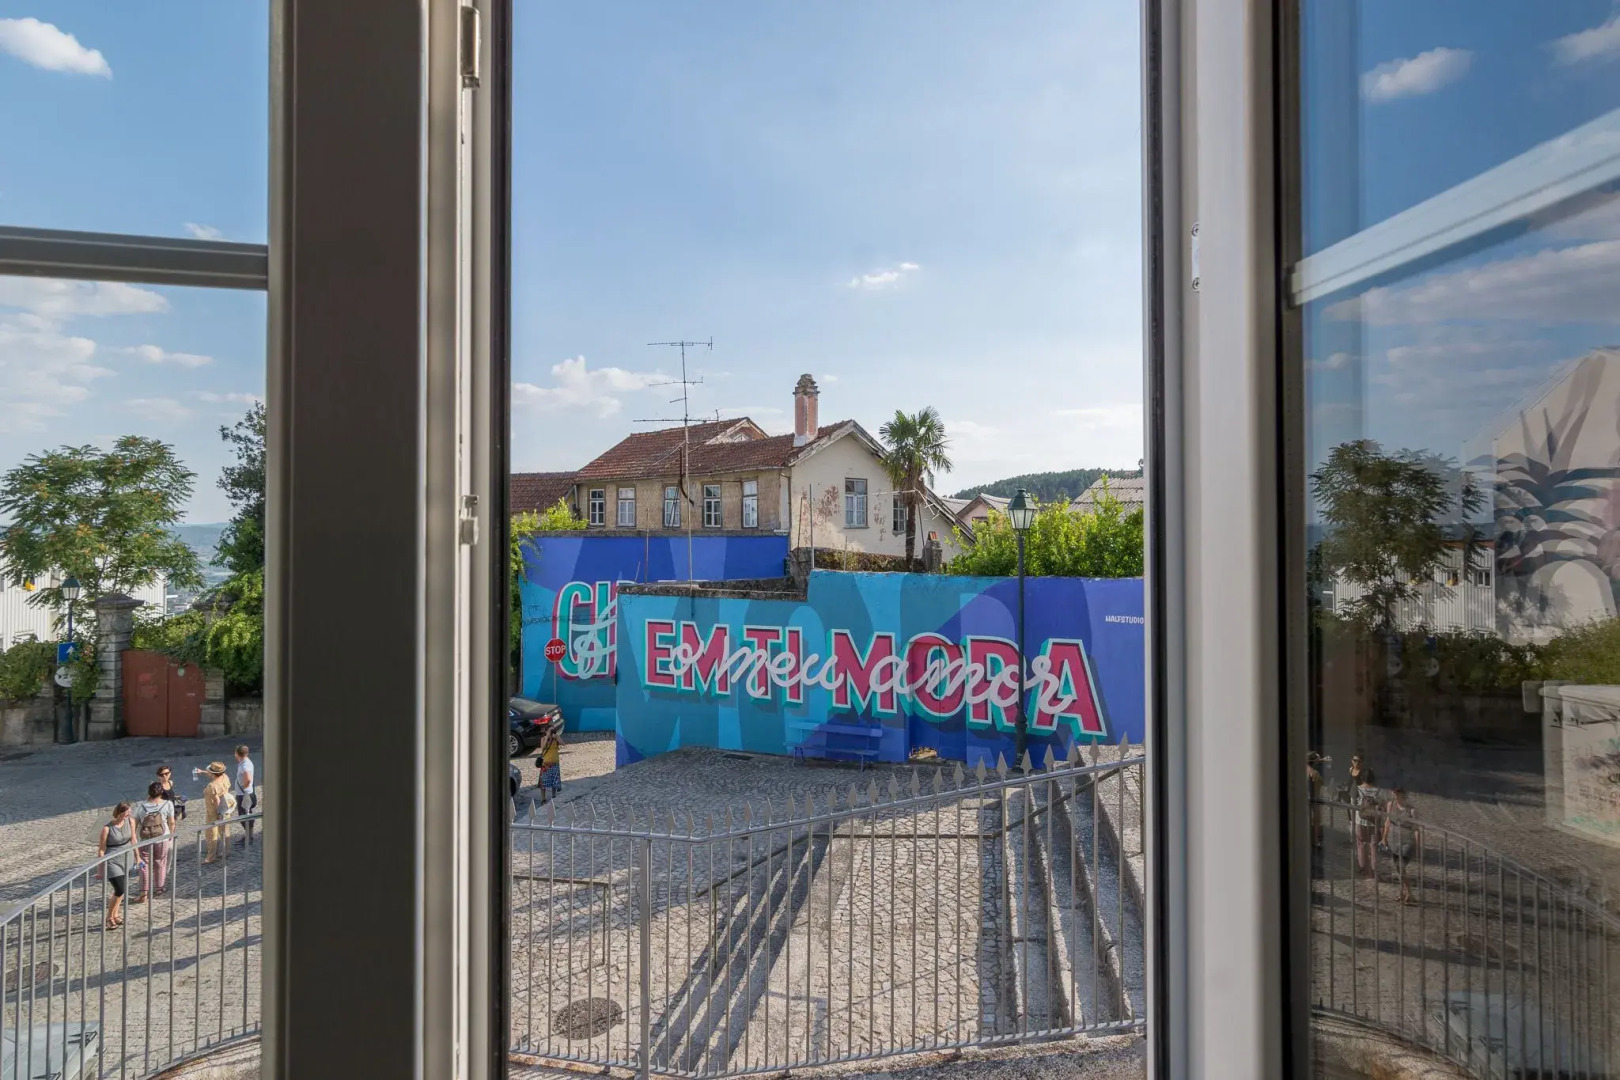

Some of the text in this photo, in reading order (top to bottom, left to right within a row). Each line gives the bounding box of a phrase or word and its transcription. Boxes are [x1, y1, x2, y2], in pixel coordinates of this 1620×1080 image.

[545, 645, 567, 656] STOP
[642, 618, 731, 696] EM
[741, 625, 804, 704] TI
[827, 628, 1107, 741] MORA
